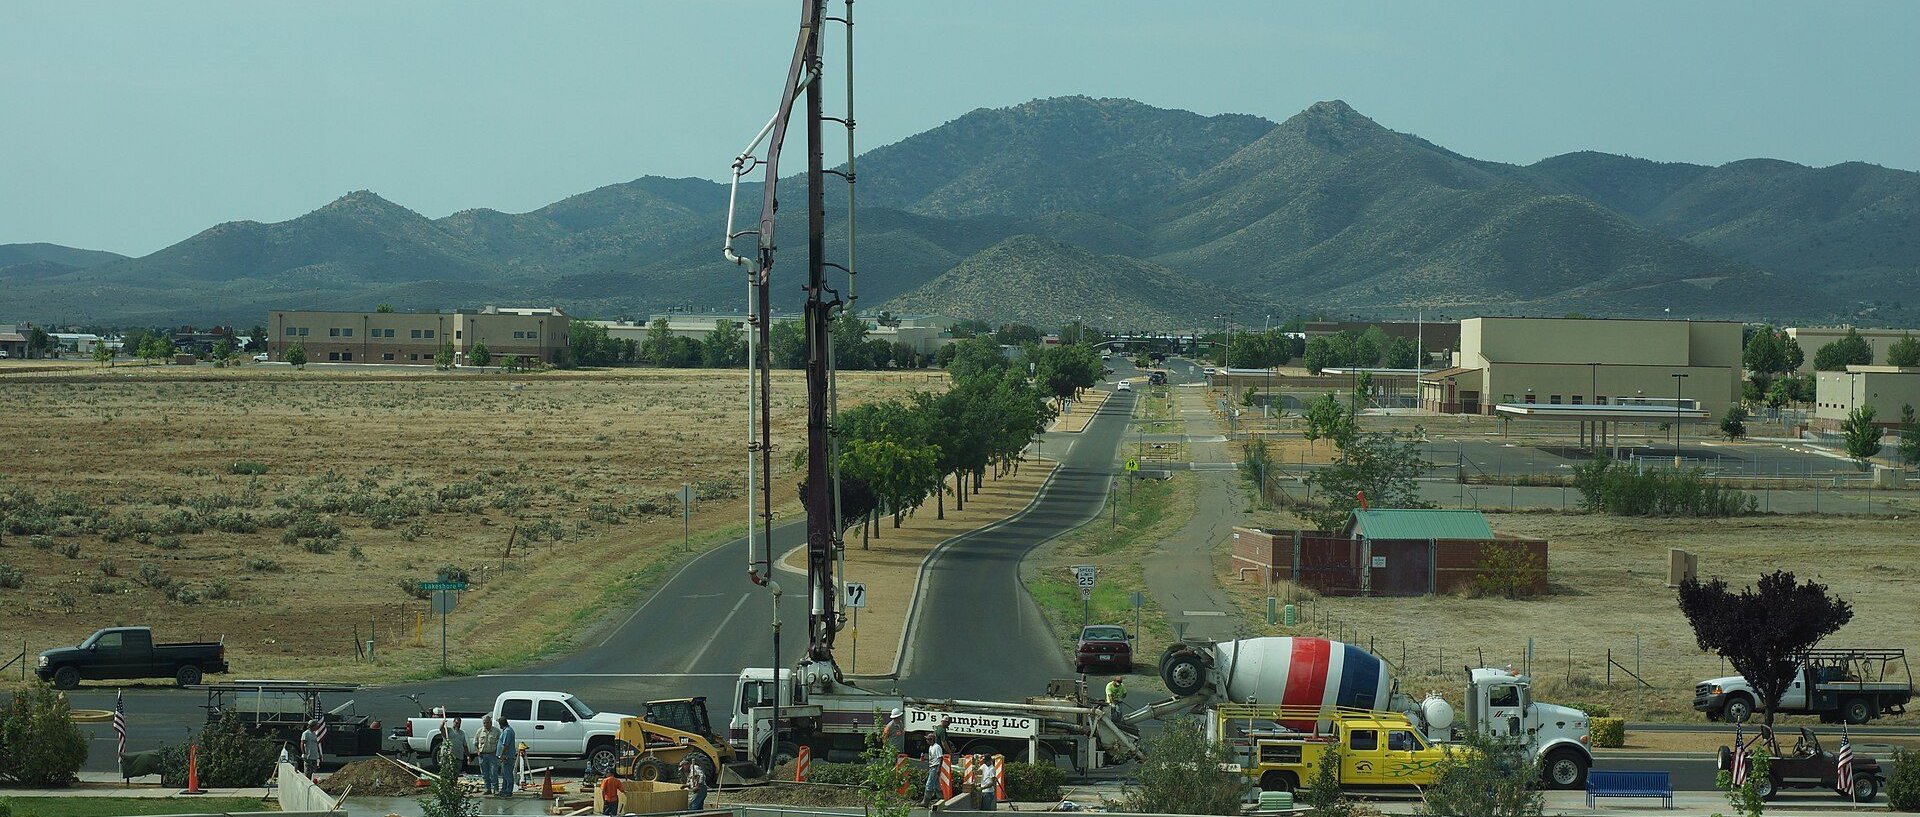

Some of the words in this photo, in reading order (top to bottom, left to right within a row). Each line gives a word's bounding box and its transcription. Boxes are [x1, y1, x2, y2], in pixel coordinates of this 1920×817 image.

[1079, 577, 1094, 586] 25
[911, 711, 937, 723] JD's
[1002, 717, 1030, 729] LLC
[932, 725, 1000, 735] 9-713-9702
